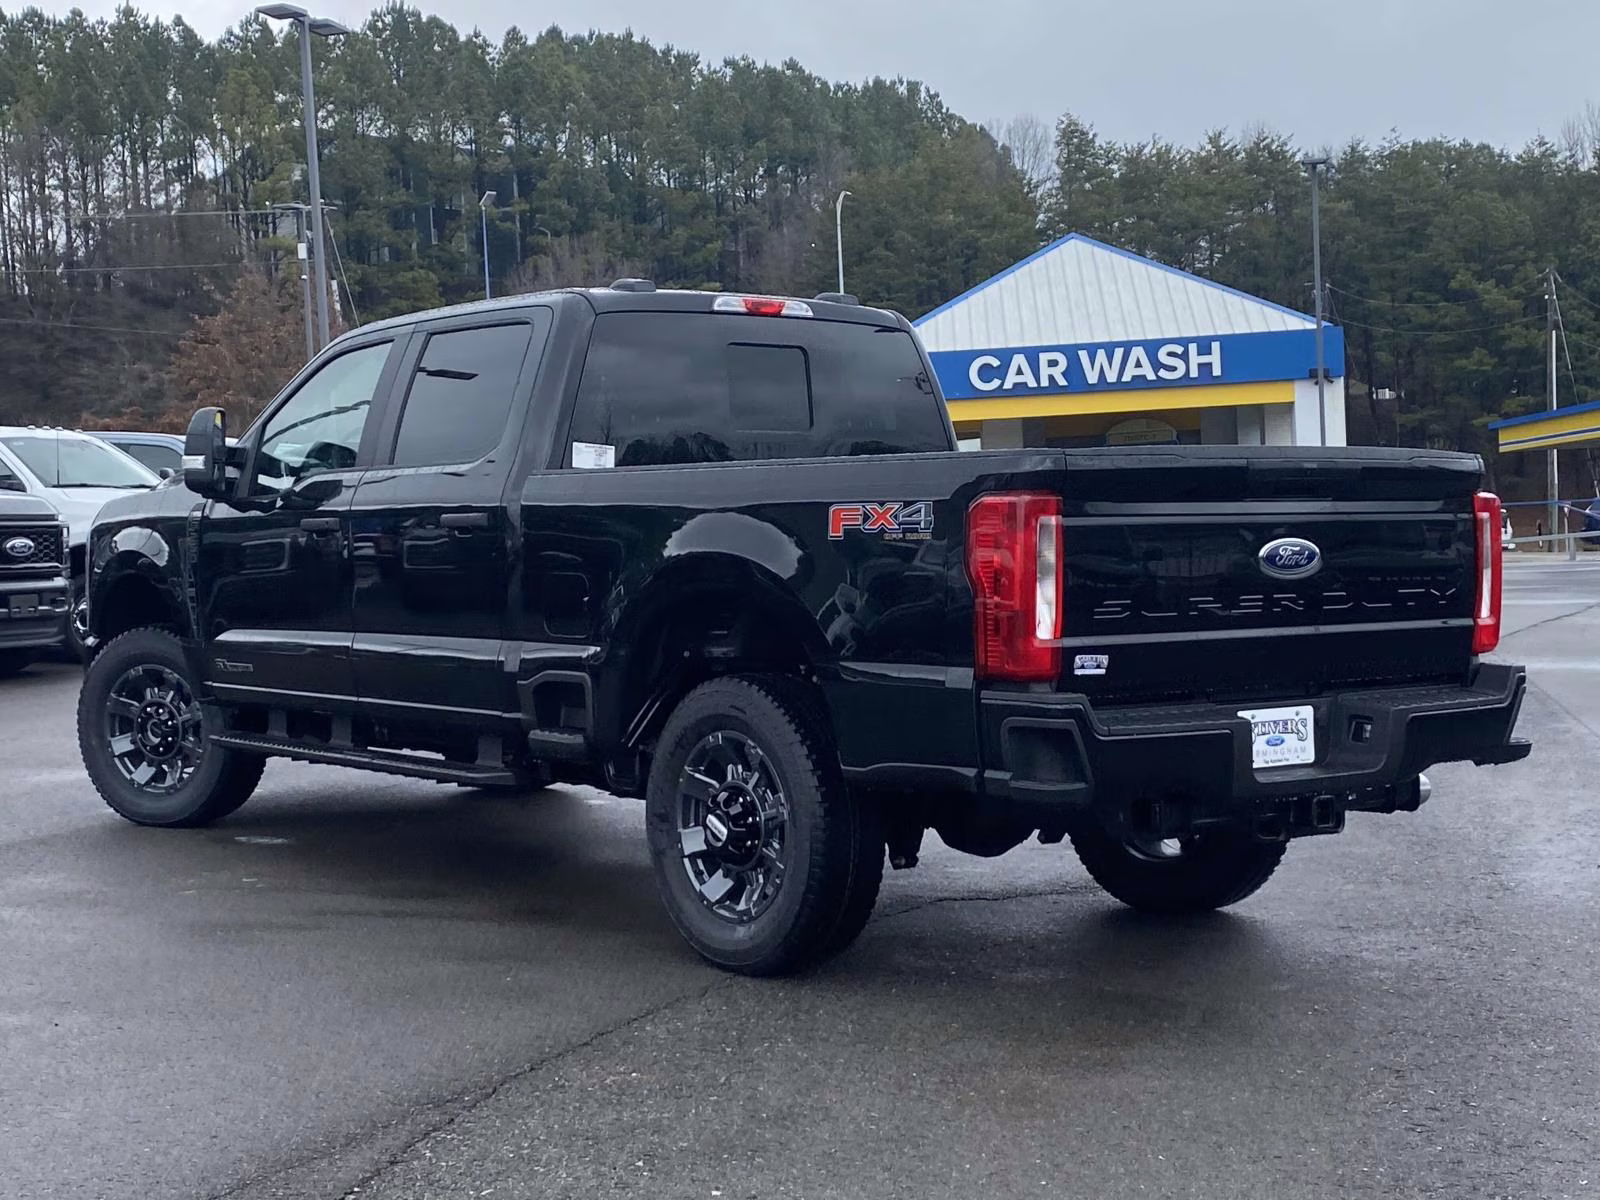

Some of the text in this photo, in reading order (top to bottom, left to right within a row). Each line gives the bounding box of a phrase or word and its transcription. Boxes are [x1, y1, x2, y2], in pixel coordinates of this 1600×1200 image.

[968, 340, 1222, 392] CAR WASH
[828, 501, 934, 540] FX4
[1276, 545, 1308, 566] Ford
